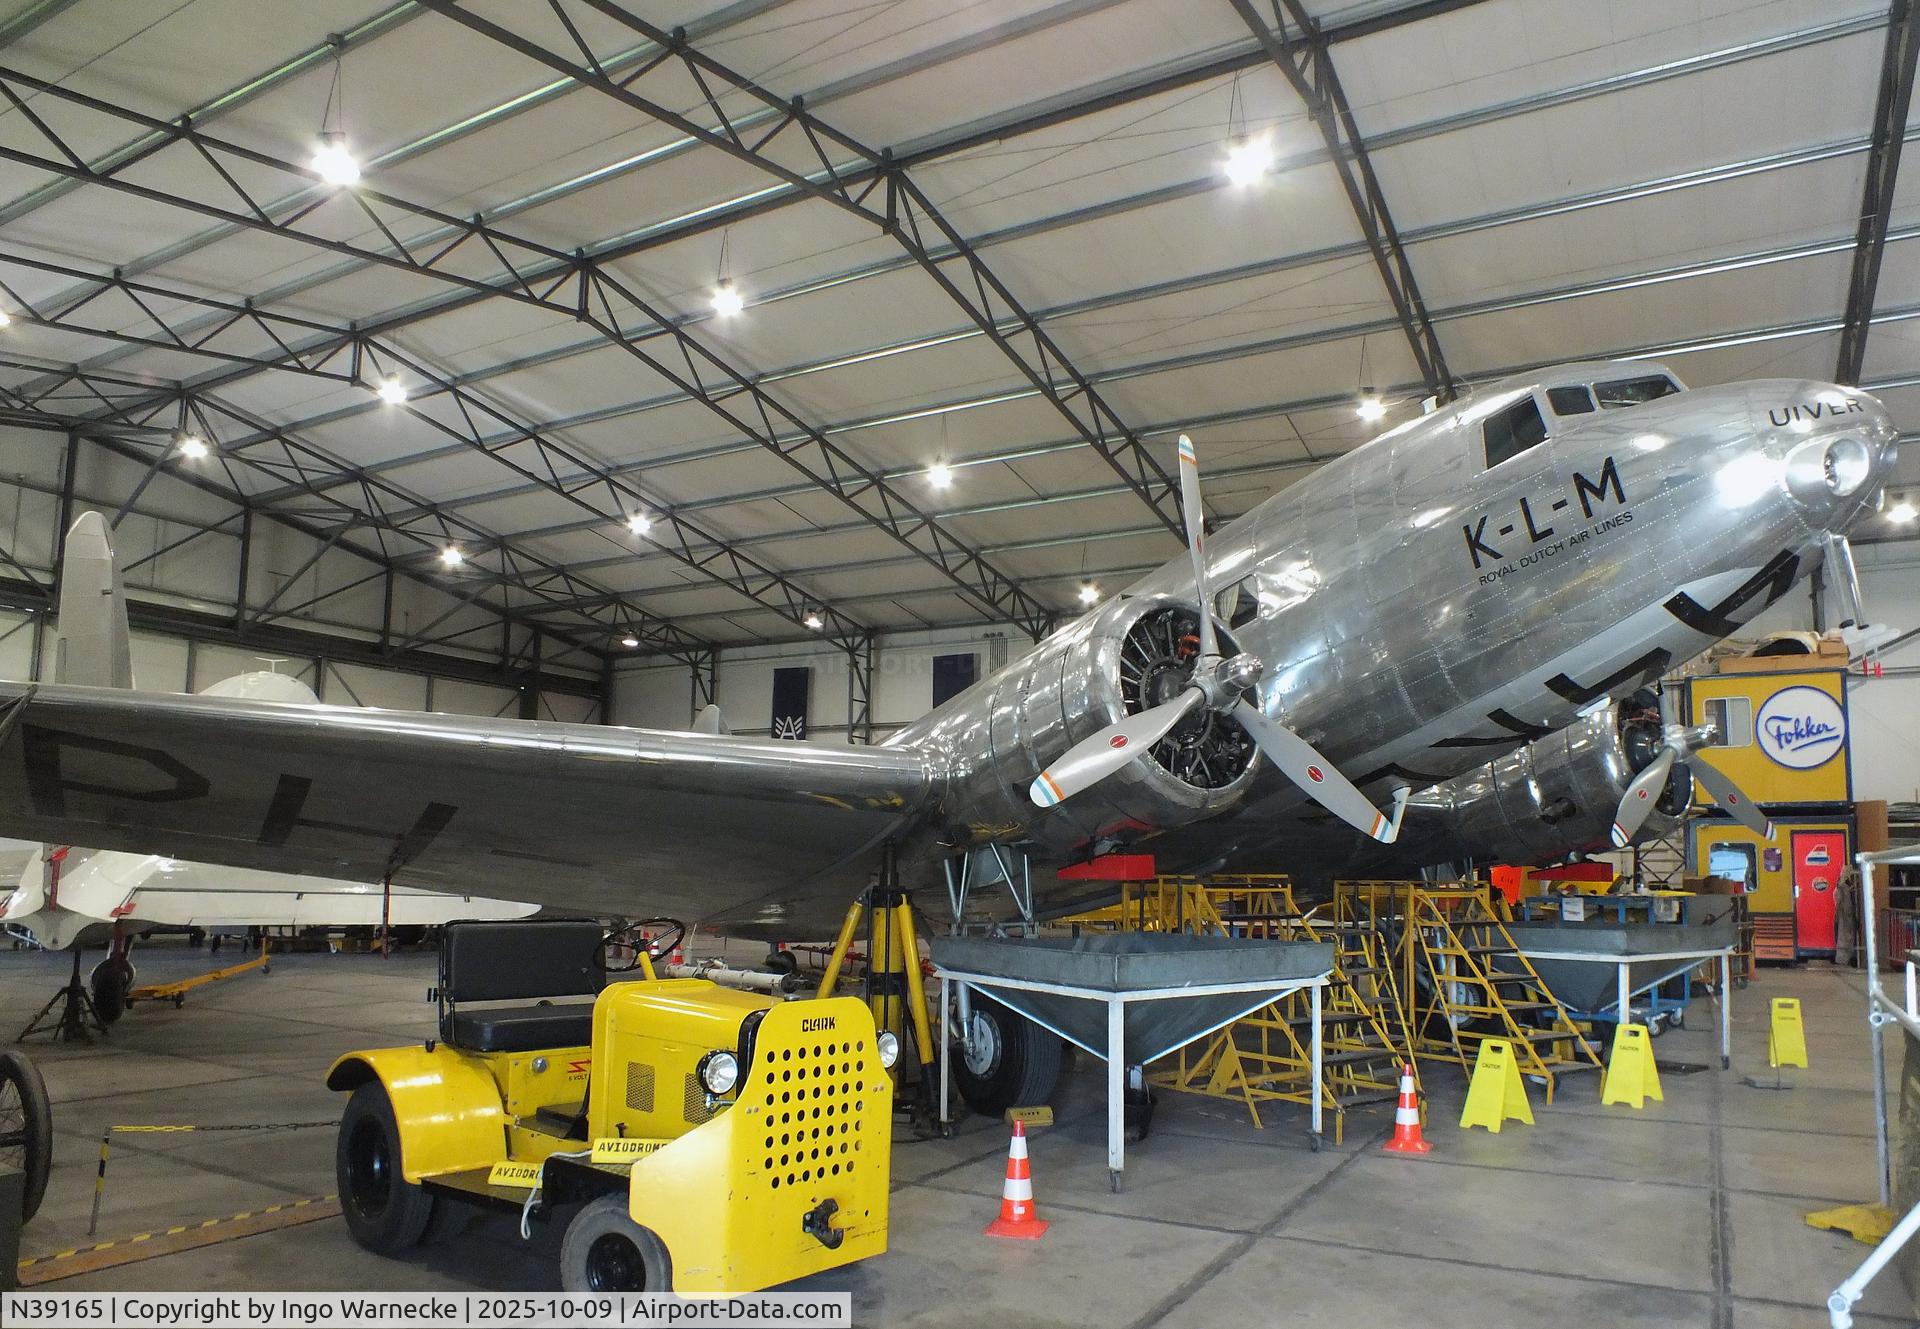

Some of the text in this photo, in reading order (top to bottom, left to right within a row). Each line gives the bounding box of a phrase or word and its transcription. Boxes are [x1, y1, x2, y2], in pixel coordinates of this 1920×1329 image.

[1769, 398, 1864, 427] UIVER
[1463, 455, 1627, 570] K-L-M
[1478, 511, 1634, 586] ROYAL DUTCH AIR LINES
[1764, 715, 1838, 750] Fokker
[802, 1016, 836, 1032] CLARK
